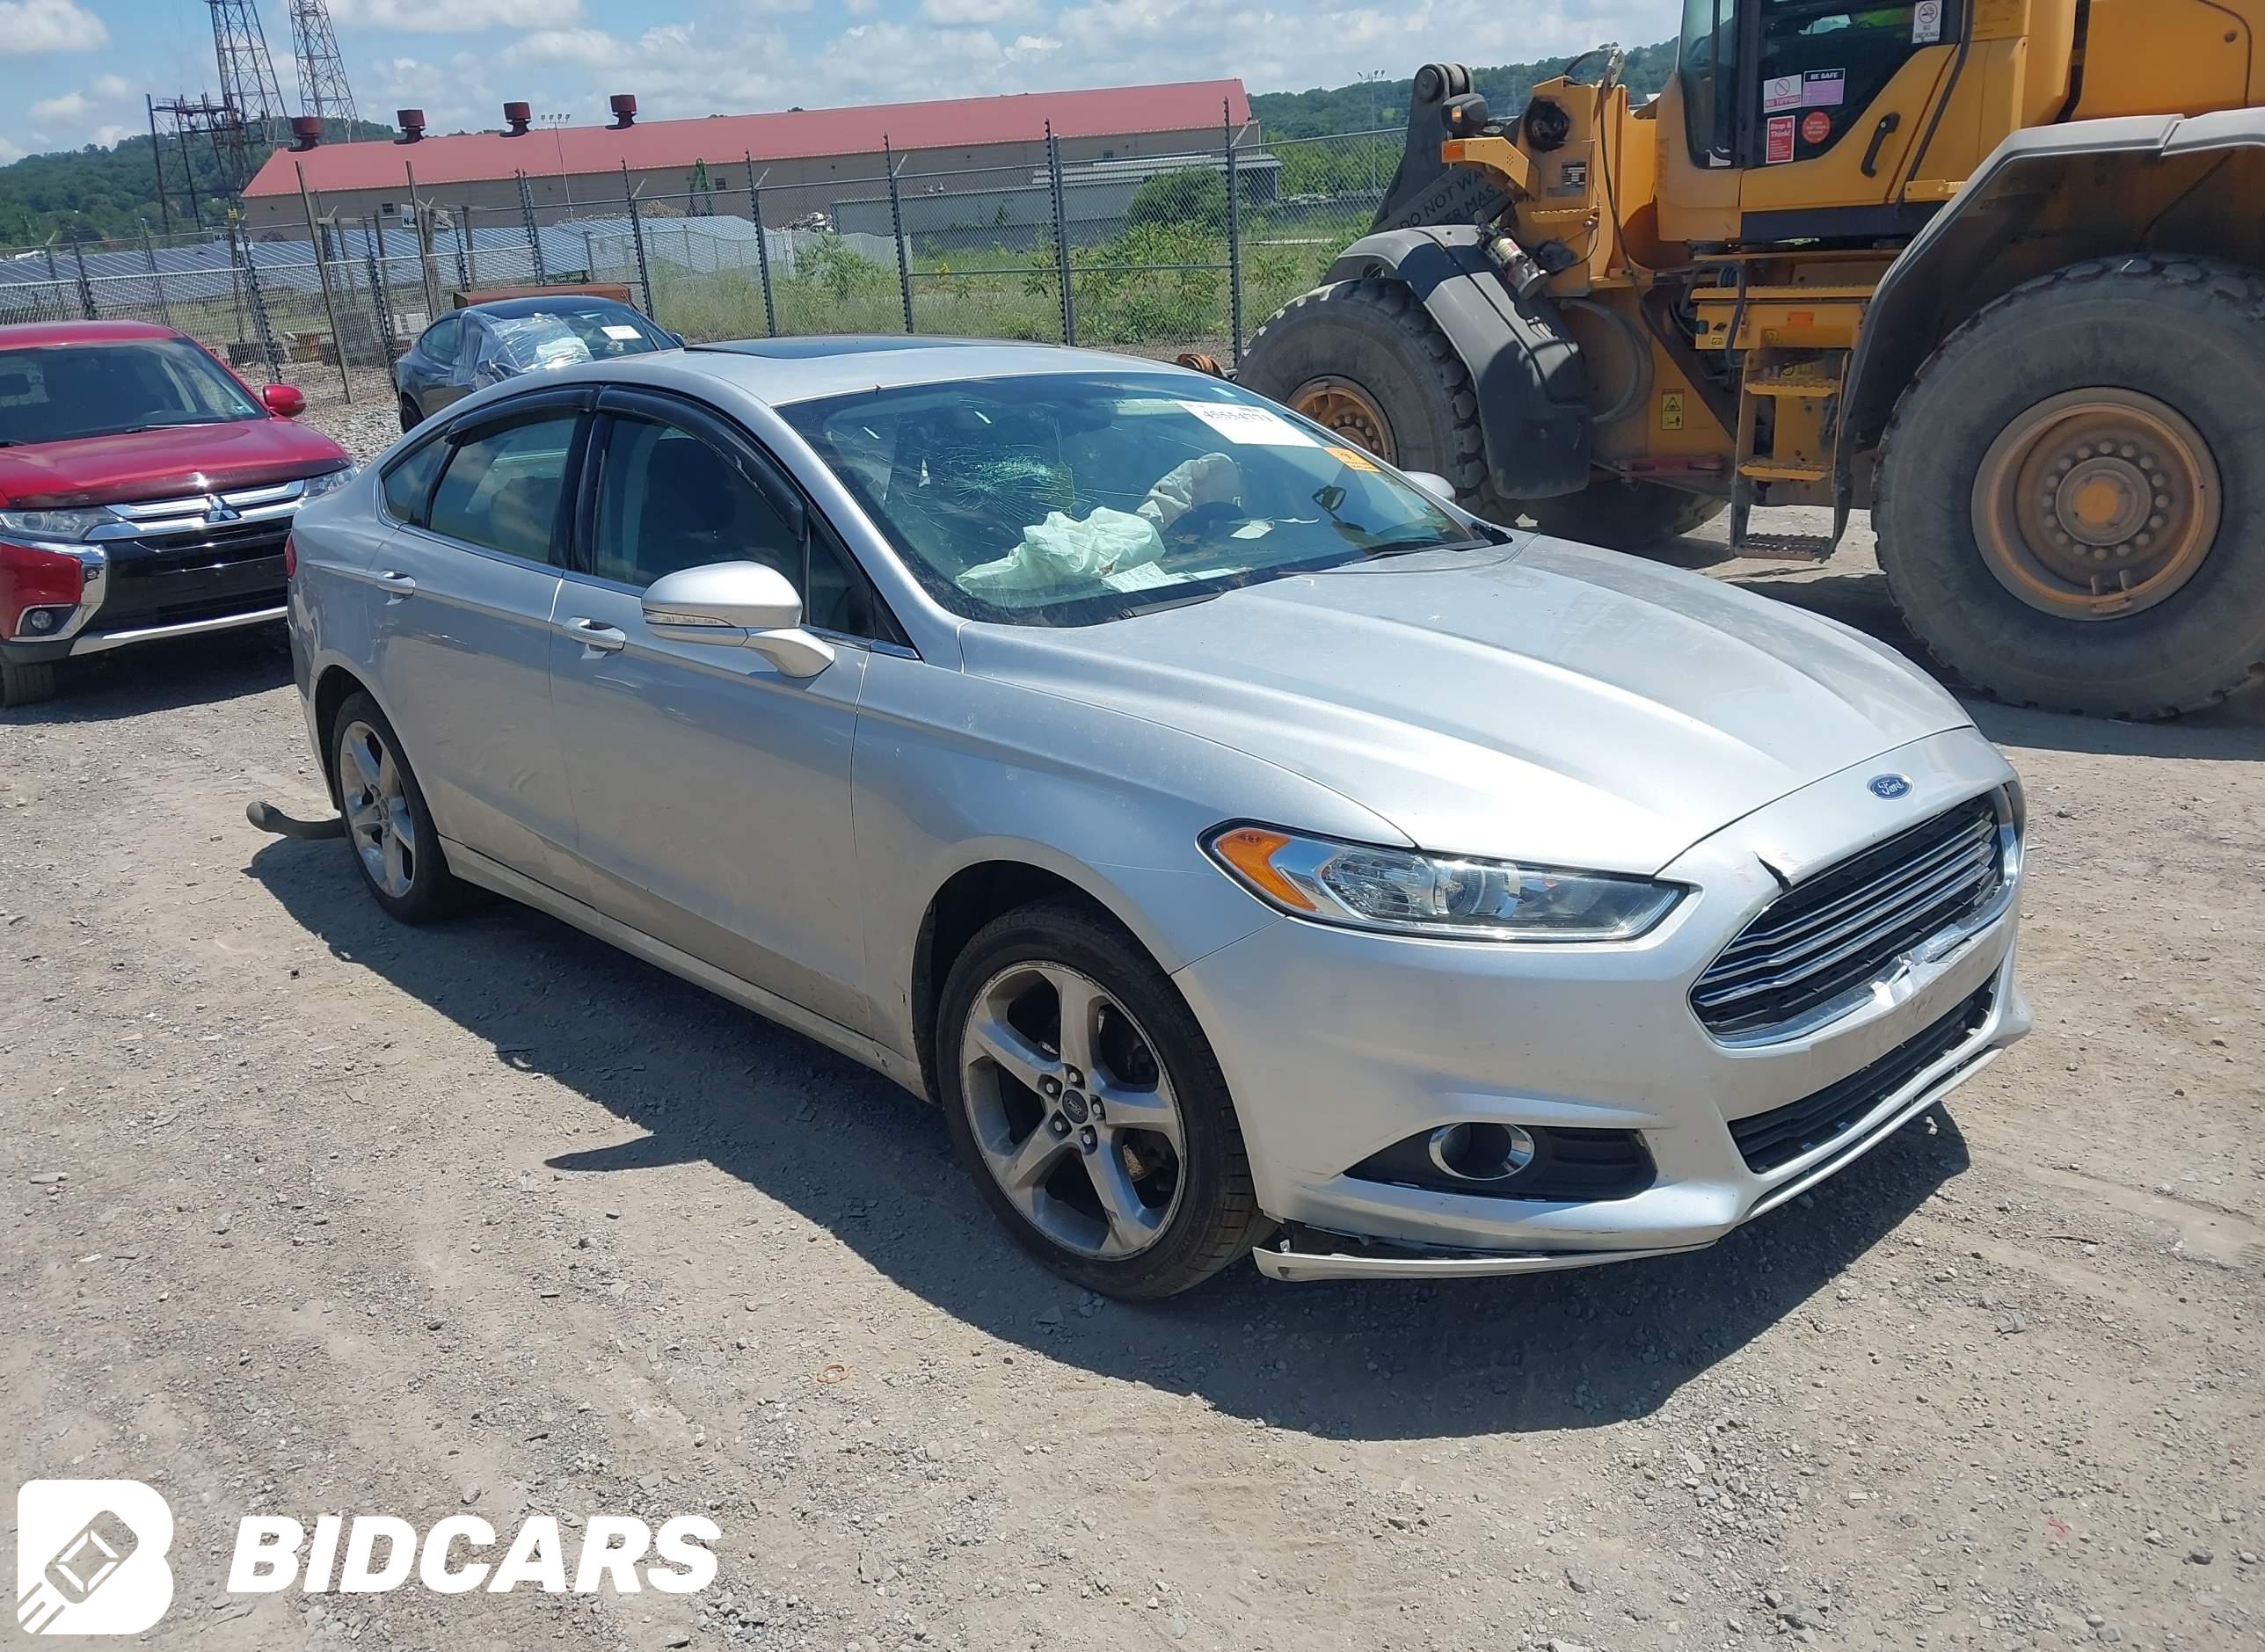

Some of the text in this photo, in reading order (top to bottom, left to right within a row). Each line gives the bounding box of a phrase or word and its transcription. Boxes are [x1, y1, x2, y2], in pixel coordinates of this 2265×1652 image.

[1399, 212, 1422, 229] DO
[1424, 185, 1454, 217] NOT
[1877, 779, 1905, 796] Ford
